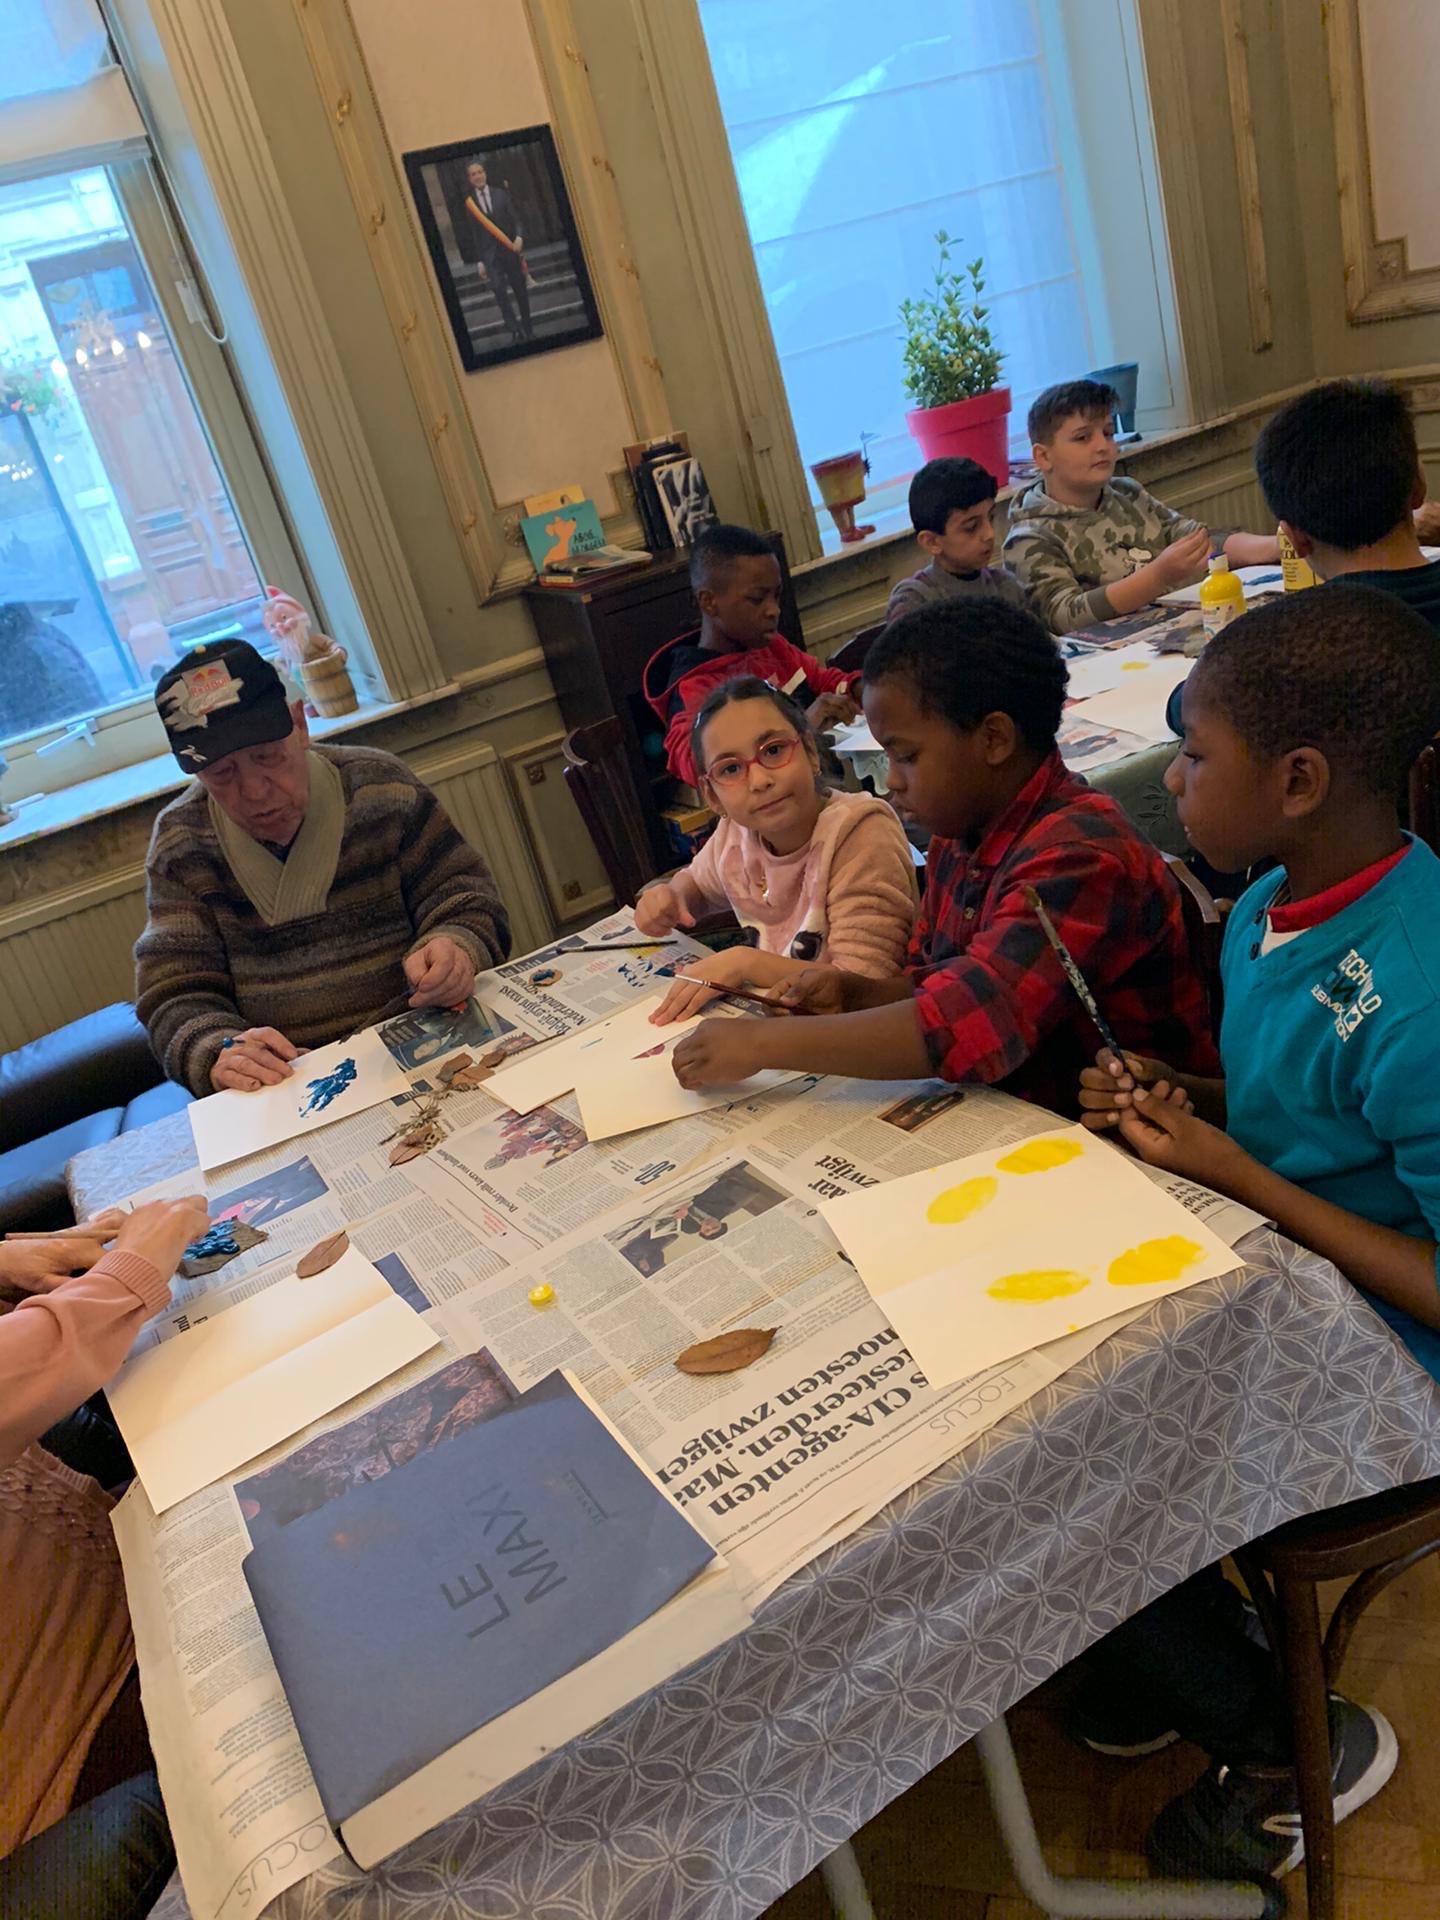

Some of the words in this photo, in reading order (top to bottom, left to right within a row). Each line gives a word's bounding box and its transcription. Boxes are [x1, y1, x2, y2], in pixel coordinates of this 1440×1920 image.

[814, 1154, 881, 1189] zwijgt
[929, 1375, 1016, 1435] FOCUS
[707, 1387, 912, 1516] CIA-agenten
[465, 1483, 568, 1605] MAXI
[439, 1562, 510, 1639] LE
[237, 1823, 328, 1908] OCUS
